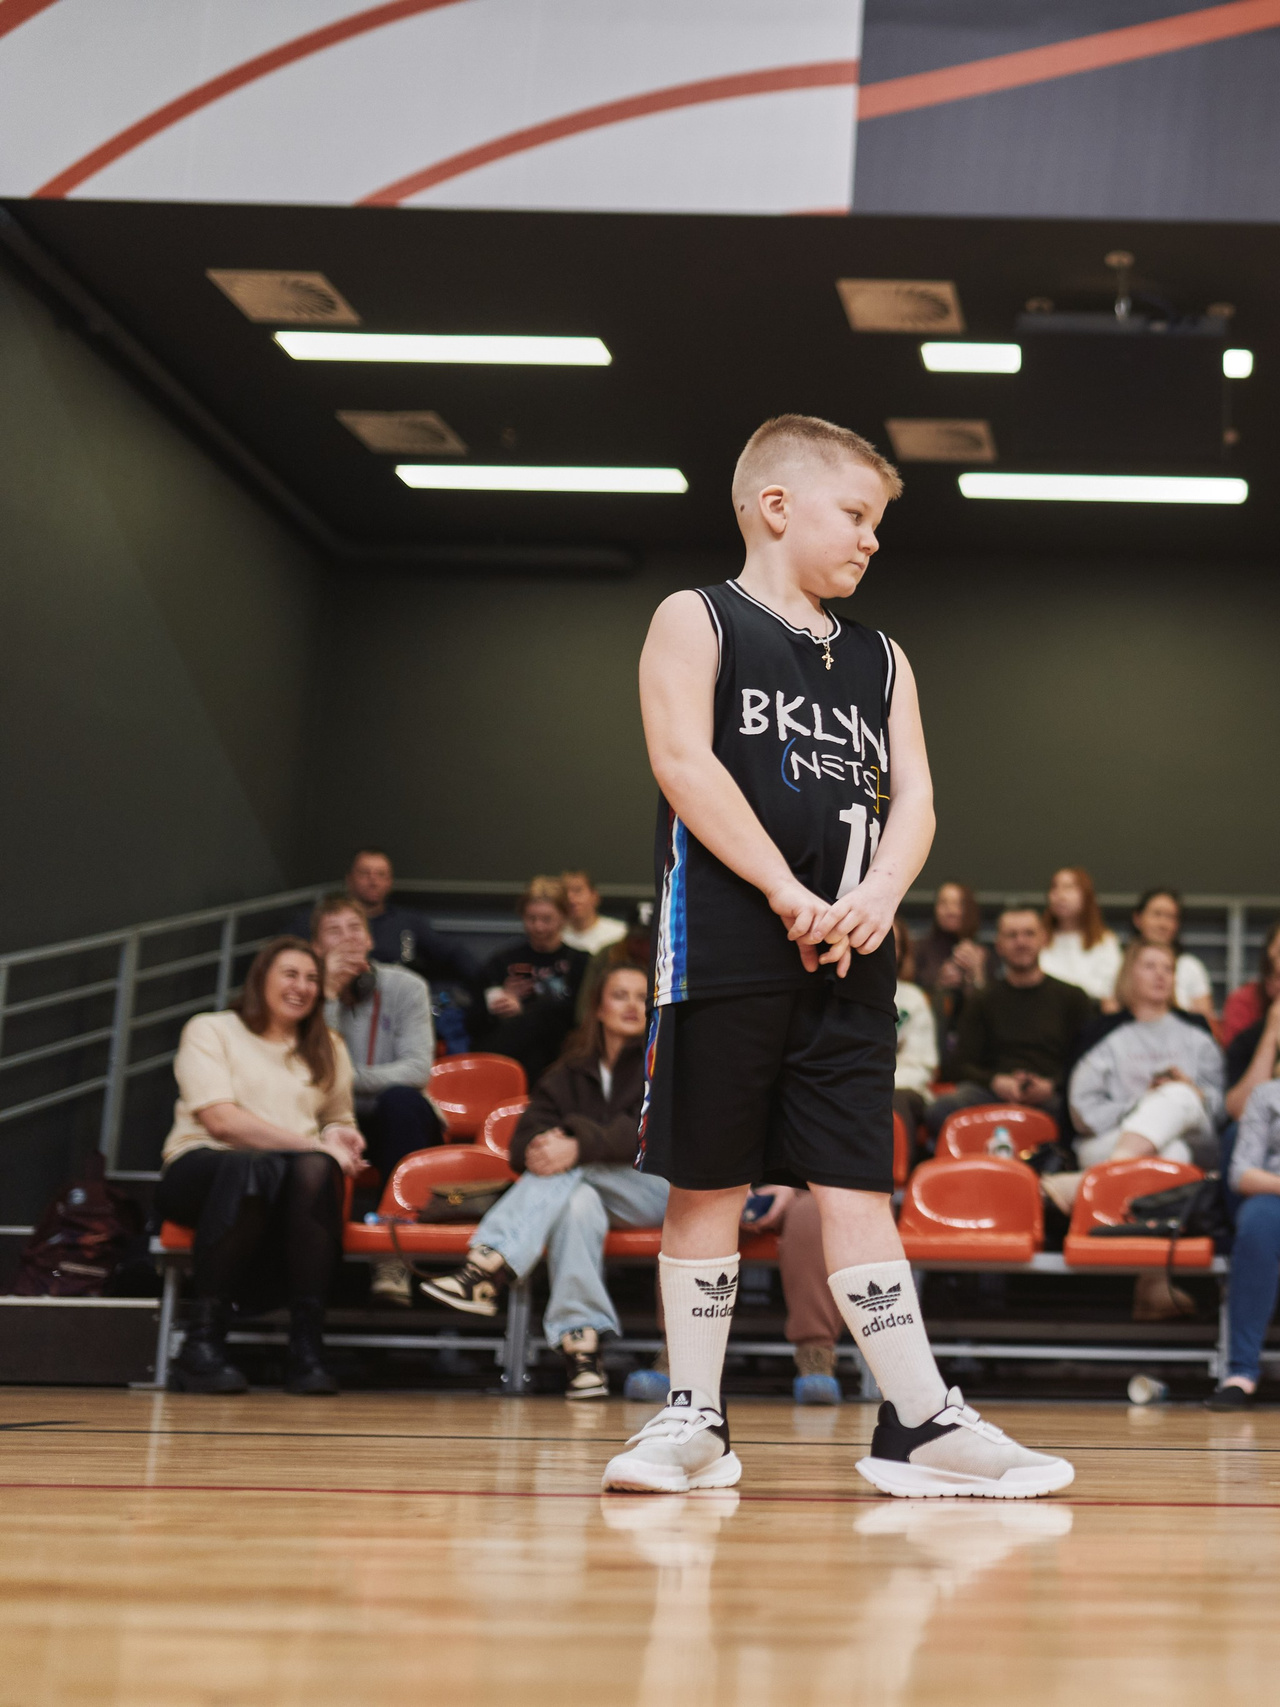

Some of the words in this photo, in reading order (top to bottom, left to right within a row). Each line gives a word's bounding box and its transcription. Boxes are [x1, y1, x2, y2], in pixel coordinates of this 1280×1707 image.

[739, 688, 888, 773] BKLYN
[790, 751, 877, 799] NETS
[862, 1313, 914, 1337] adidas
